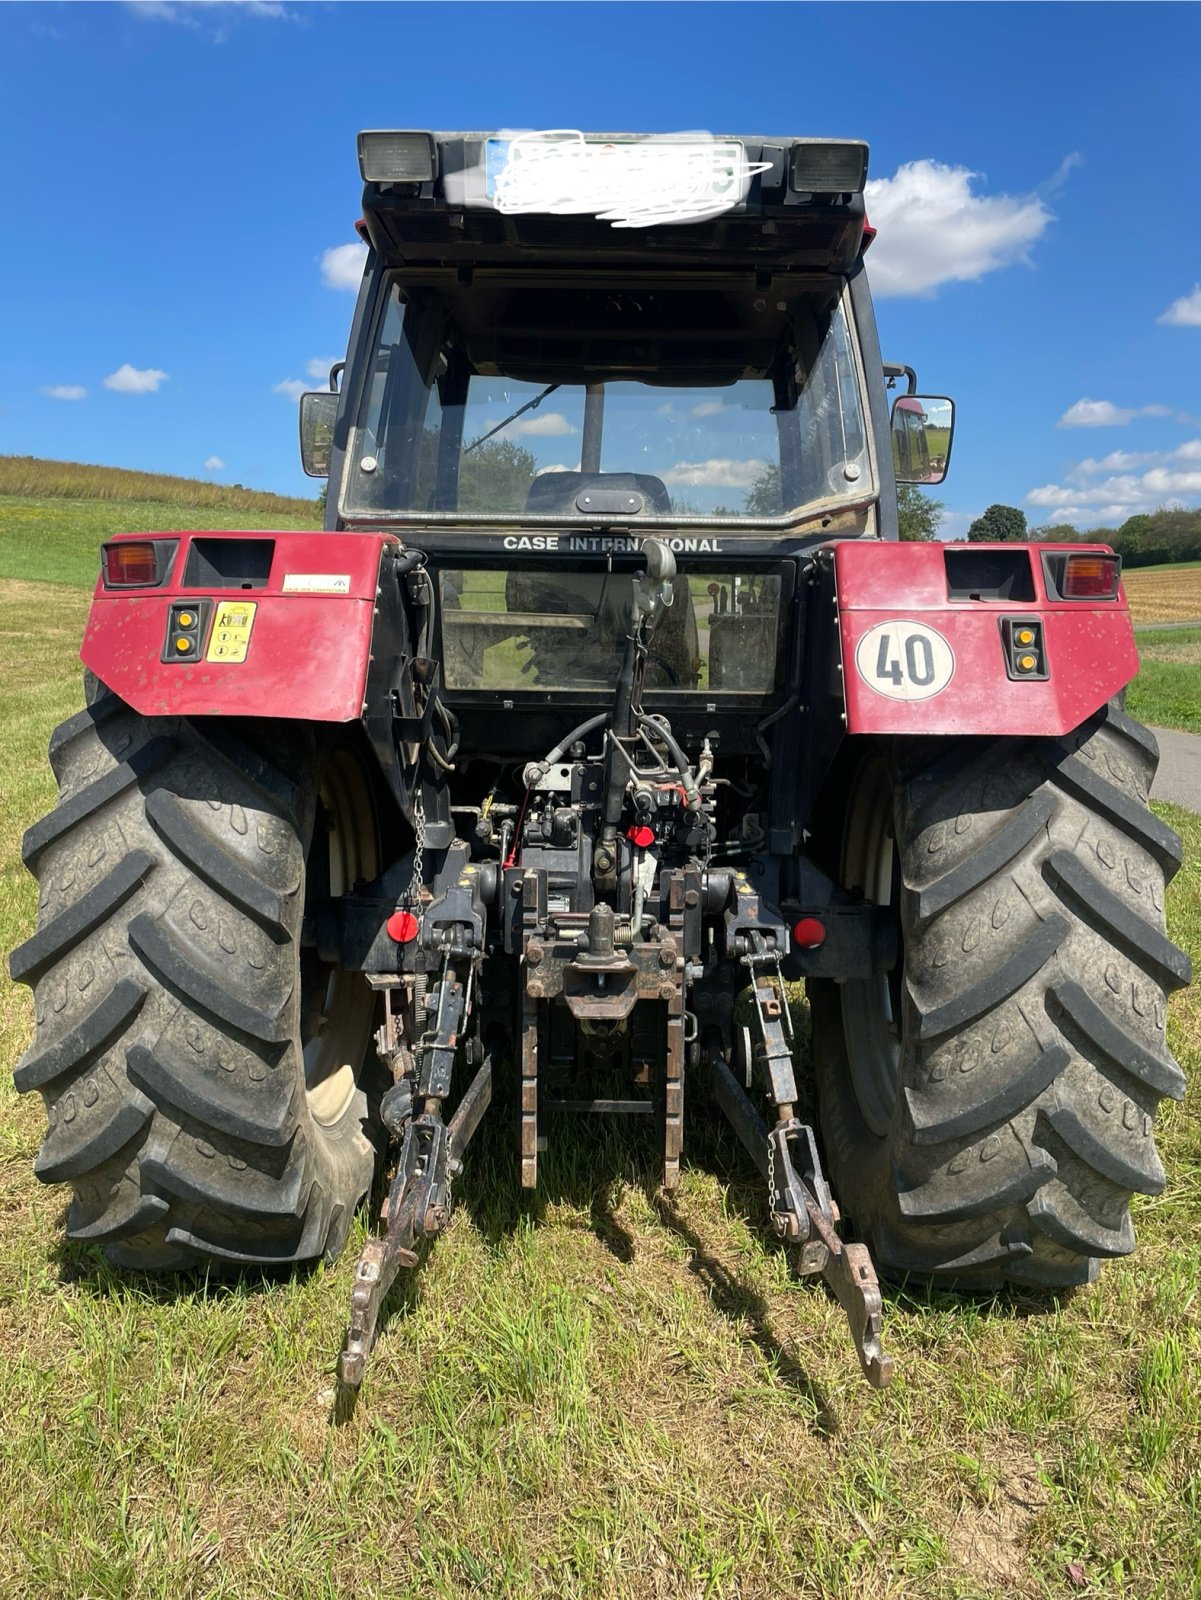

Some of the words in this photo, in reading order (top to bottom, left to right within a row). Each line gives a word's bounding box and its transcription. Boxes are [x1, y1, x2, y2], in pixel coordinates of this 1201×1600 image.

[503, 536, 559, 551] CASE
[569, 537, 723, 552] INTERNONAL
[876, 633, 936, 686] 40
